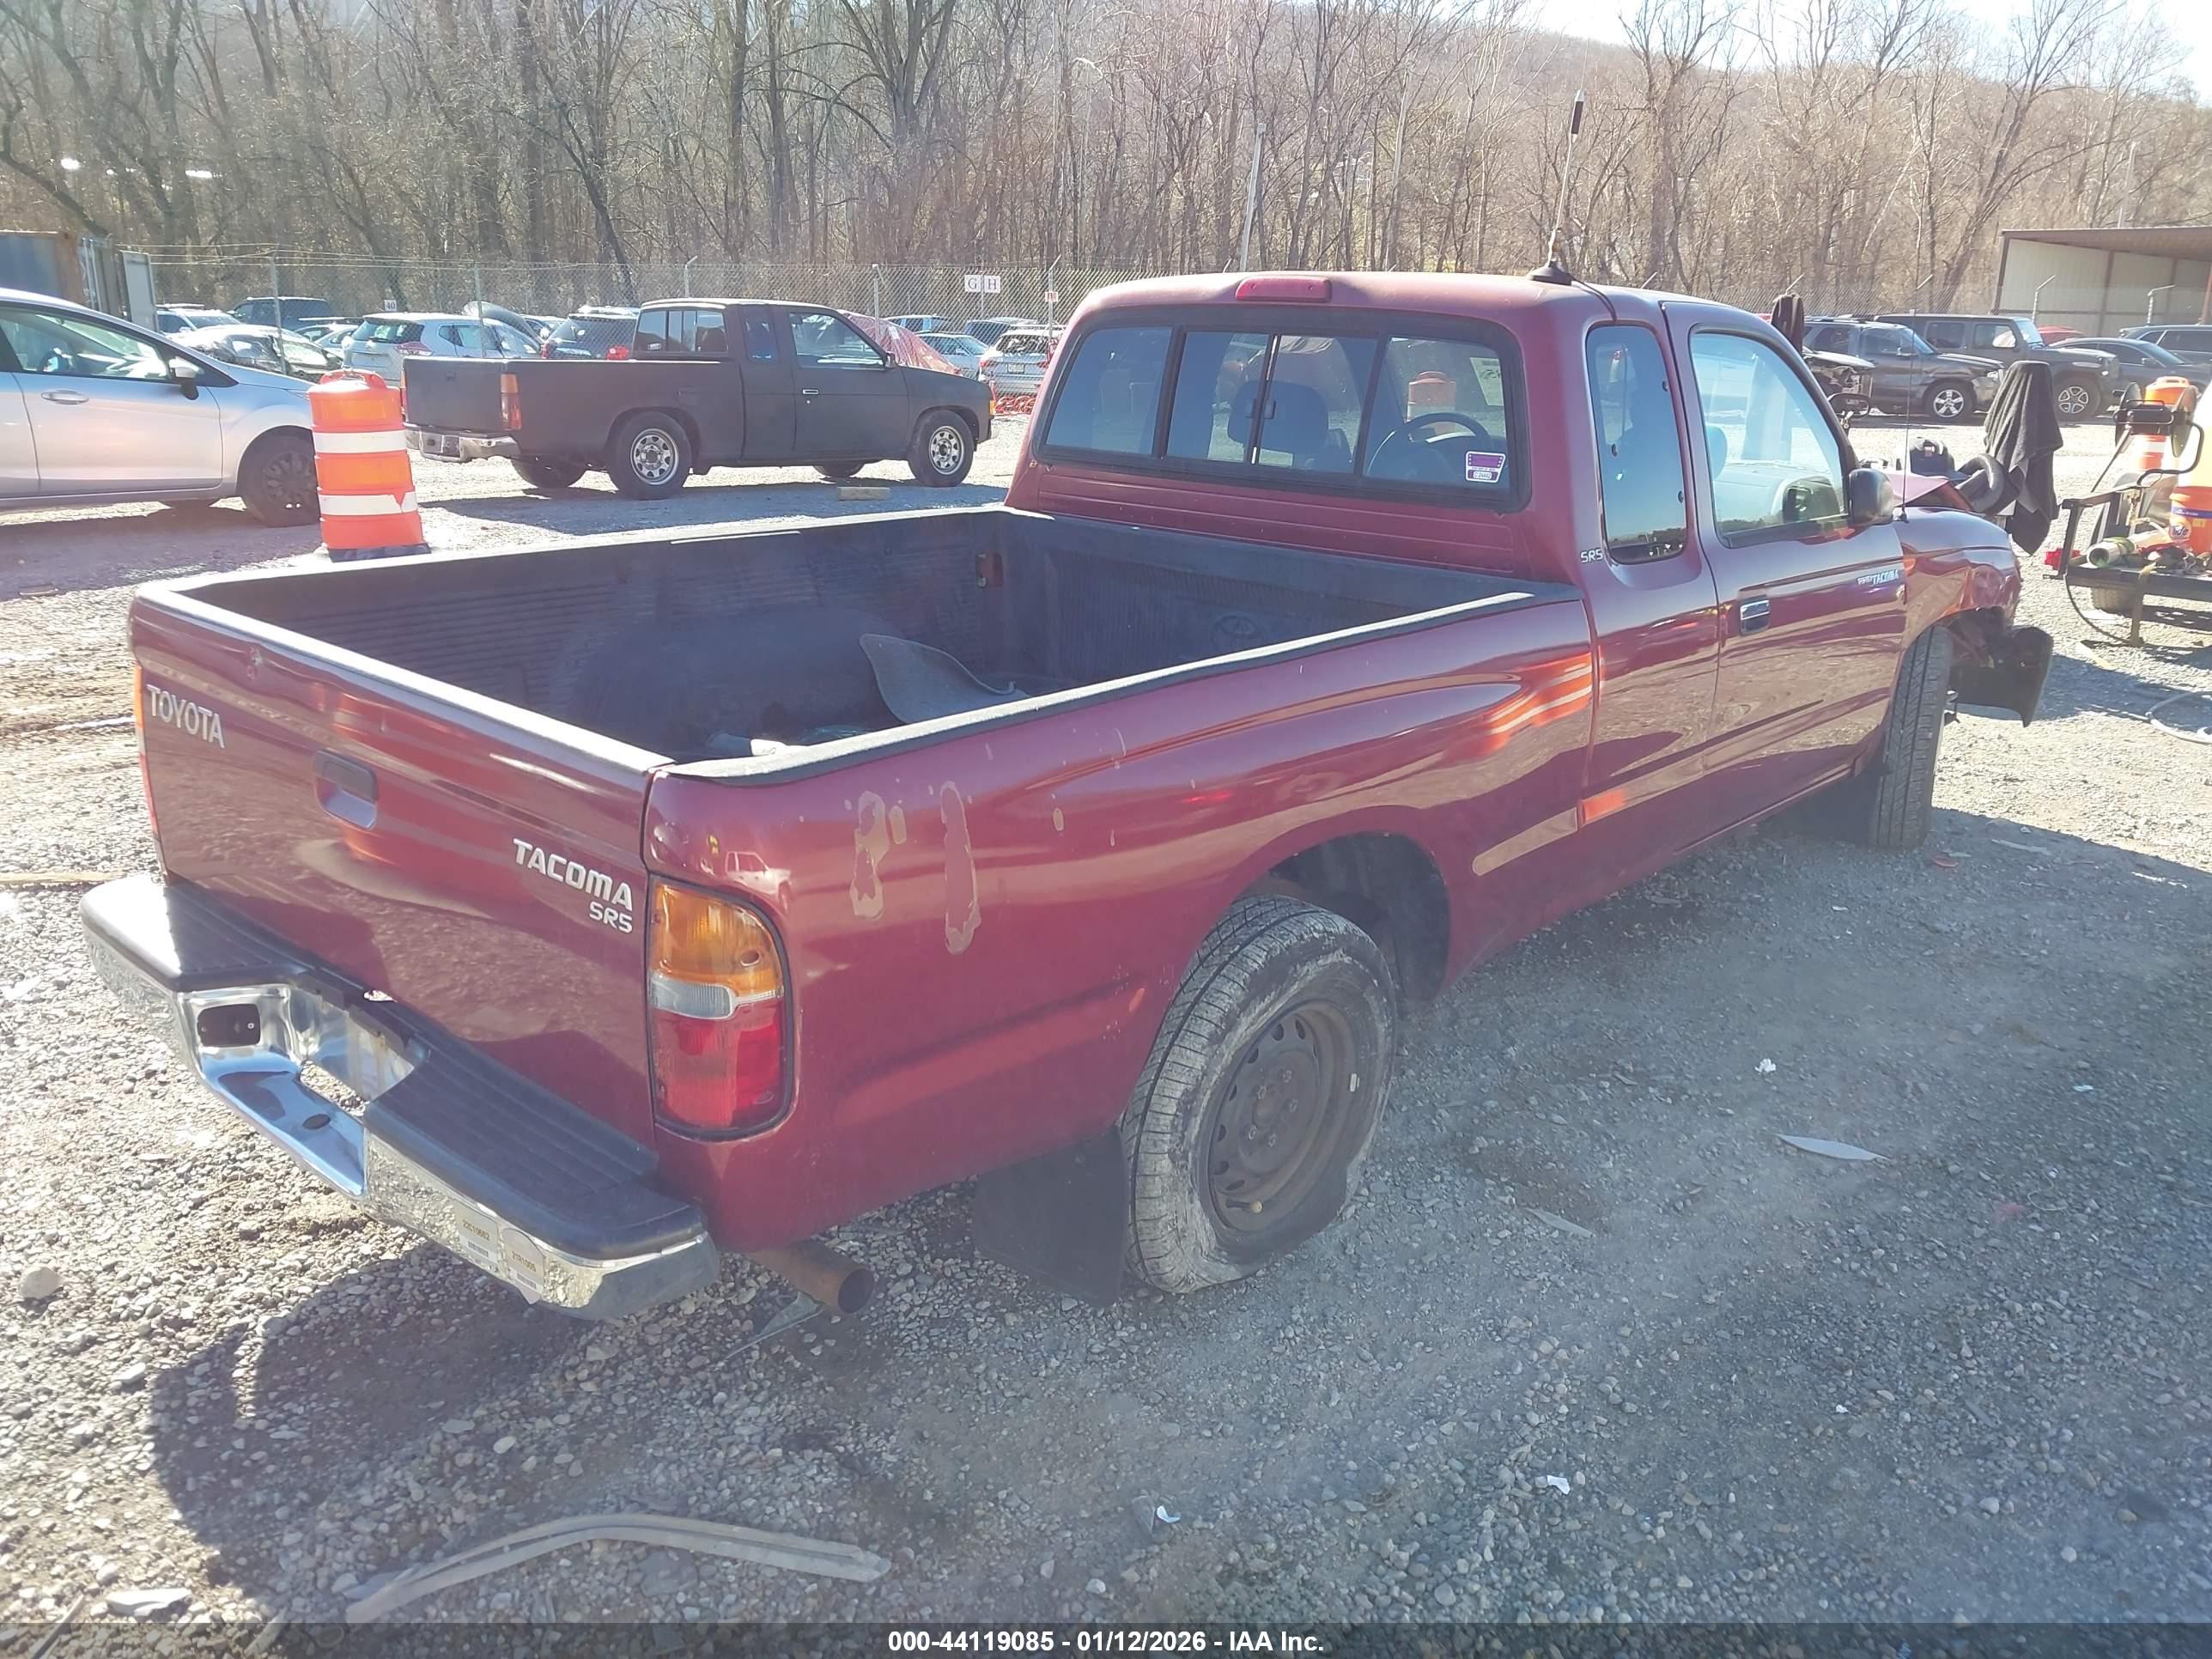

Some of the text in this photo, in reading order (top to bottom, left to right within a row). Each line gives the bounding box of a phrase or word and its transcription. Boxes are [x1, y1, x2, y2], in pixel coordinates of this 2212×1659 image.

[968, 277, 977, 289] G
[988, 278, 997, 290] H
[1580, 549, 1603, 563] SR5
[146, 684, 225, 749] TOYOTA
[513, 837, 633, 912] TACOMA
[589, 901, 633, 933] SR5
